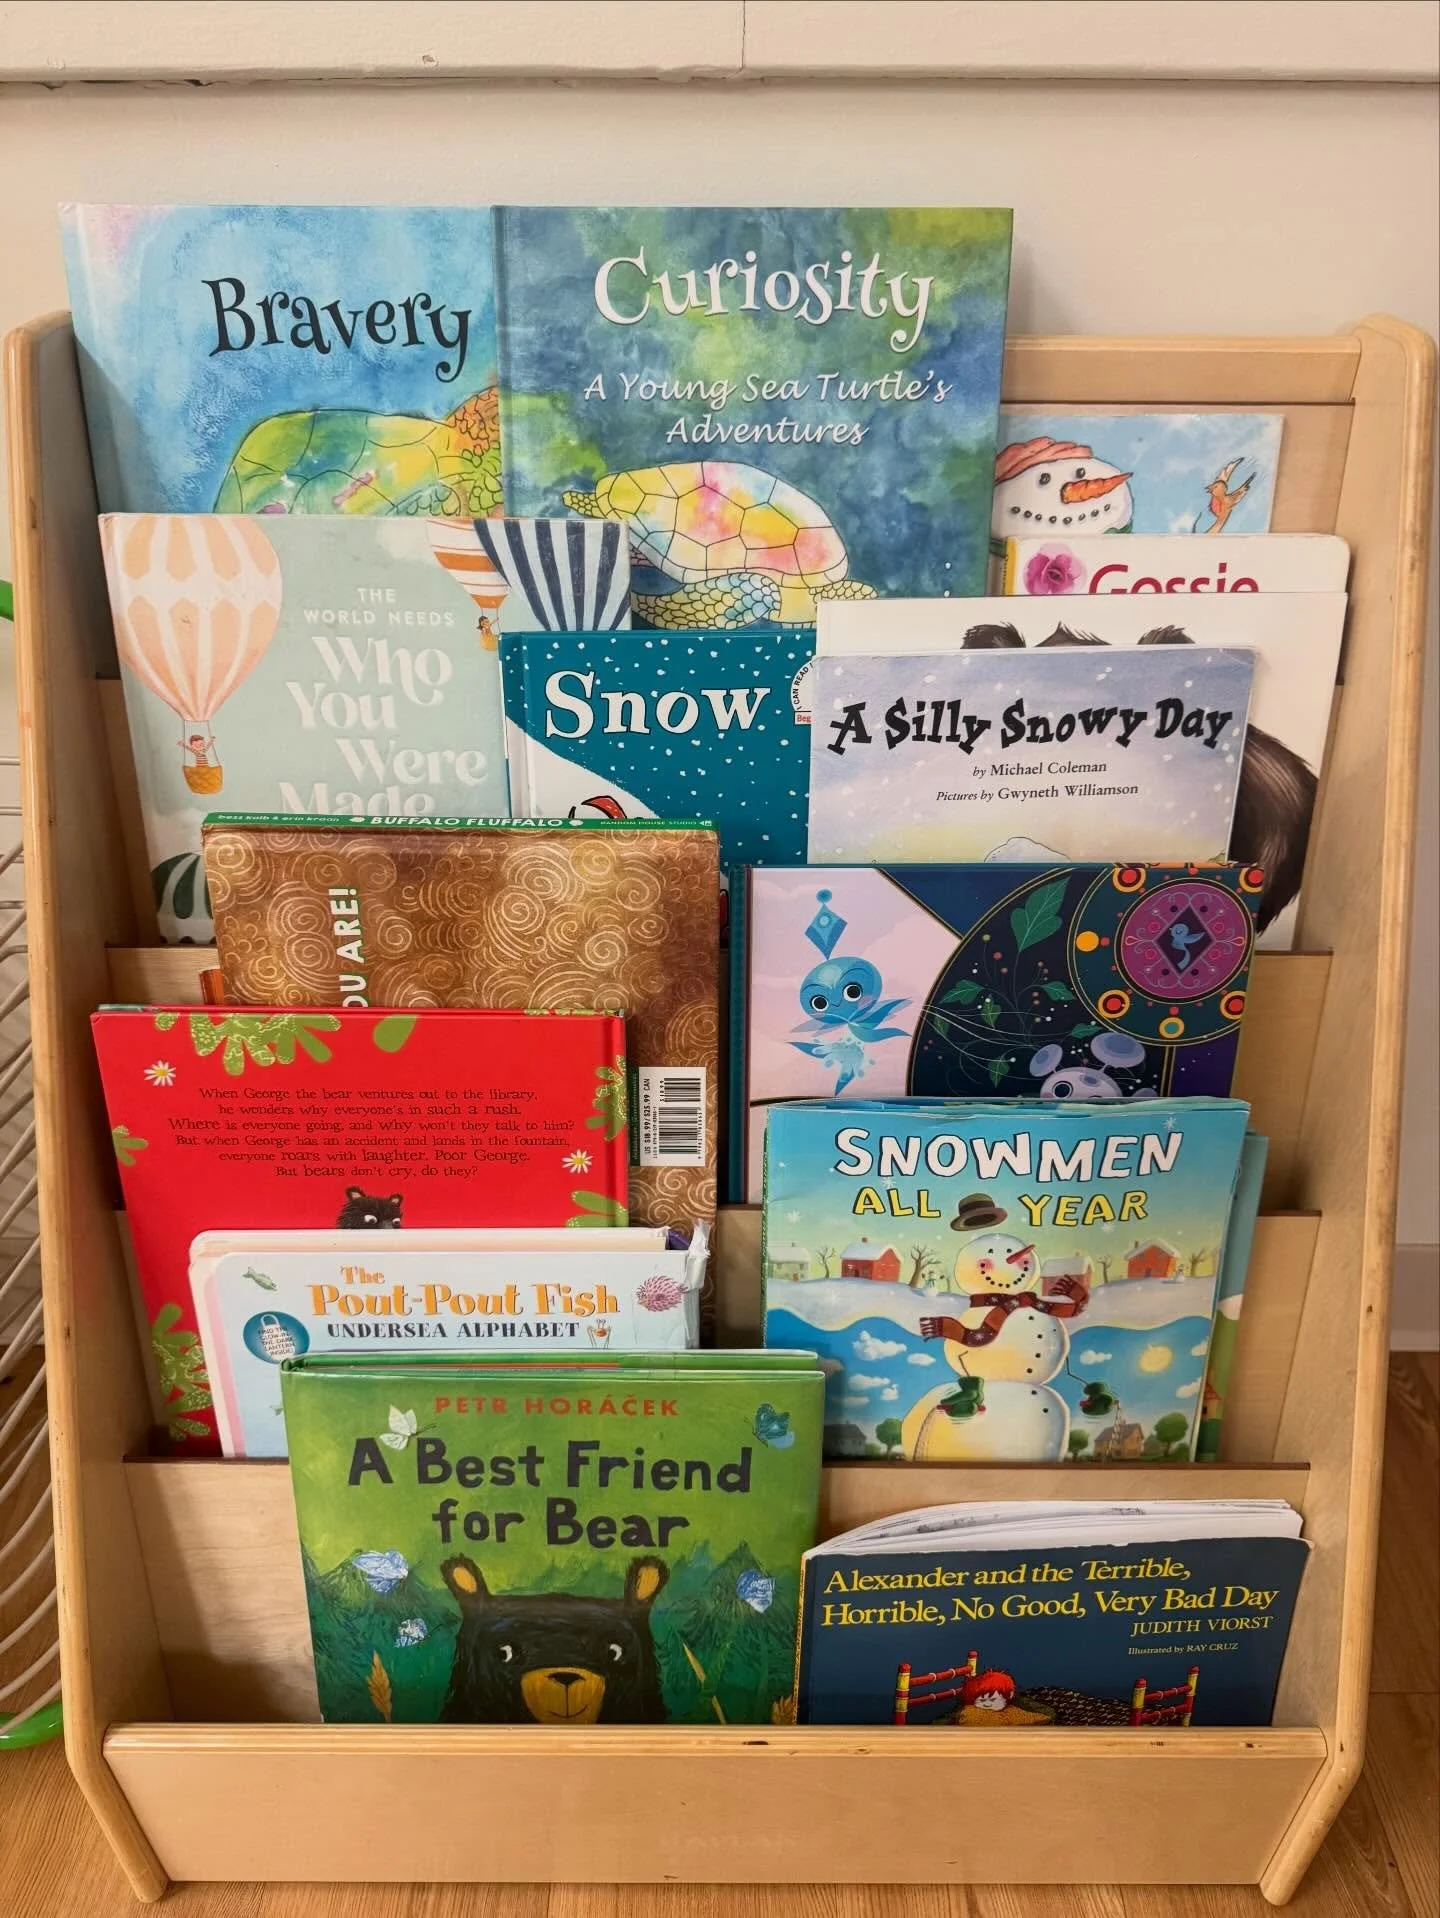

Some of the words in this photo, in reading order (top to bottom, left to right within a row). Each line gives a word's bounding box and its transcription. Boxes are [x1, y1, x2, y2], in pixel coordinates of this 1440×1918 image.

[594, 246, 935, 353] Curiosity
[201, 277, 472, 383] Bravery
[584, 373, 607, 401] A
[619, 374, 736, 410] Young
[742, 373, 811, 401] Sea
[817, 370, 953, 403] Turtle's
[665, 414, 870, 445] Adventures
[358, 588, 396, 603] THE
[303, 609, 376, 624] WORLD
[389, 611, 456, 626] NEEDS
[312, 636, 453, 705] Who
[794, 666, 809, 686] READ
[286, 682, 398, 730] You
[545, 670, 771, 738] Snow
[792, 688, 800, 705] CAN
[827, 702, 872, 755] A
[884, 697, 992, 755] Silly
[1000, 698, 1147, 749] Snowy
[1154, 697, 1233, 749] Day
[335, 738, 488, 786] Were
[973, 766, 986, 779] by
[990, 762, 1043, 777] Michael
[1047, 761, 1107, 774] Coleman
[278, 781, 435, 816] Made
[936, 791, 977, 802] Pictures
[980, 789, 994, 802] by
[997, 786, 1059, 802] Gwyneth
[1064, 783, 1139, 798] Williamson
[371, 816, 461, 825] BUFFALO
[466, 818, 562, 827] FLUFFALO
[329, 889, 364, 964] ARE!
[199, 1087, 239, 1099] When
[244, 1088, 290, 1101] George
[296, 1088, 317, 1099] the
[322, 1088, 352, 1099] bear
[358, 1089, 413, 1099] ventures
[419, 1089, 439, 1099] out
[445, 1089, 458, 1099] to
[463, 1089, 484, 1099] the
[489, 1088, 538, 1101] library,
[217, 1104, 234, 1114] he
[240, 1104, 294, 1115] wonders
[300, 1104, 328, 1117] why
[334, 1105, 403, 1117] everyone's
[409, 1104, 422, 1115] in
[427, 1103, 461, 1115] such
[468, 1105, 478, 1115] a
[167, 1118, 221, 1130] Where
[226, 1120, 238, 1130] is
[241, 1121, 301, 1133] everyone
[305, 1120, 345, 1133] going,
[348, 1119, 372, 1130] and
[419, 1120, 455, 1131] won't
[461, 1120, 489, 1133] they
[495, 1120, 520, 1131] talk
[525, 1121, 538, 1131] to
[543, 1120, 575, 1131] him?
[175, 1135, 197, 1146] But
[204, 1136, 240, 1146] when
[245, 1135, 290, 1148] George
[295, 1135, 318, 1146] has
[323, 1137, 340, 1146] an
[344, 1136, 398, 1146] accident
[403, 1136, 427, 1146] and
[432, 1136, 465, 1146] lands
[470, 1136, 483, 1146] in
[487, 1136, 509, 1146] the
[514, 1136, 570, 1147] fountain,
[834, 1127, 1184, 1183] SNOWMEN
[218, 1152, 275, 1163] everyone
[281, 1151, 320, 1162] roars
[326, 1151, 356, 1161] with
[434, 1150, 466, 1161] Poor
[473, 1150, 530, 1165] George.
[276, 1166, 298, 1176] But
[304, 1165, 345, 1177] bears
[351, 1166, 383, 1176] don't
[388, 1167, 417, 1179] cry,
[421, 1165, 437, 1176] do
[444, 1166, 478, 1178] they?
[853, 1186, 942, 1220] ALL
[1018, 1189, 1149, 1228] YEAR
[339, 1266, 386, 1285] The
[305, 1283, 524, 1317] Pout-Pout
[530, 1283, 620, 1318] Fish
[327, 1321, 448, 1339] UNDERSEA
[457, 1321, 580, 1338] ALPHABET
[434, 1397, 508, 1415] PETR
[524, 1394, 680, 1417] HORÁČEK
[348, 1437, 394, 1486] A
[416, 1437, 545, 1489] Best
[566, 1440, 752, 1494] Friend
[432, 1498, 525, 1543] for
[546, 1497, 690, 1549] Bear
[823, 1565, 969, 1594] Alexander
[974, 1562, 1027, 1585] and
[1031, 1561, 1073, 1582] the
[1081, 1557, 1191, 1582] Terrible,
[821, 1600, 946, 1627] Horrible,
[950, 1596, 994, 1621] No
[1002, 1592, 1087, 1619] Good,
[1095, 1591, 1156, 1616] Very
[1161, 1587, 1214, 1611] Bad
[1224, 1585, 1279, 1611] Day
[1131, 1619, 1201, 1638] JUDITH
[1207, 1615, 1275, 1632] VIORST
[1128, 1645, 1170, 1655] Illustrated
[1174, 1645, 1185, 1655] by
[1186, 1643, 1207, 1653] RAY
[1209, 1642, 1239, 1652] CRUZ
